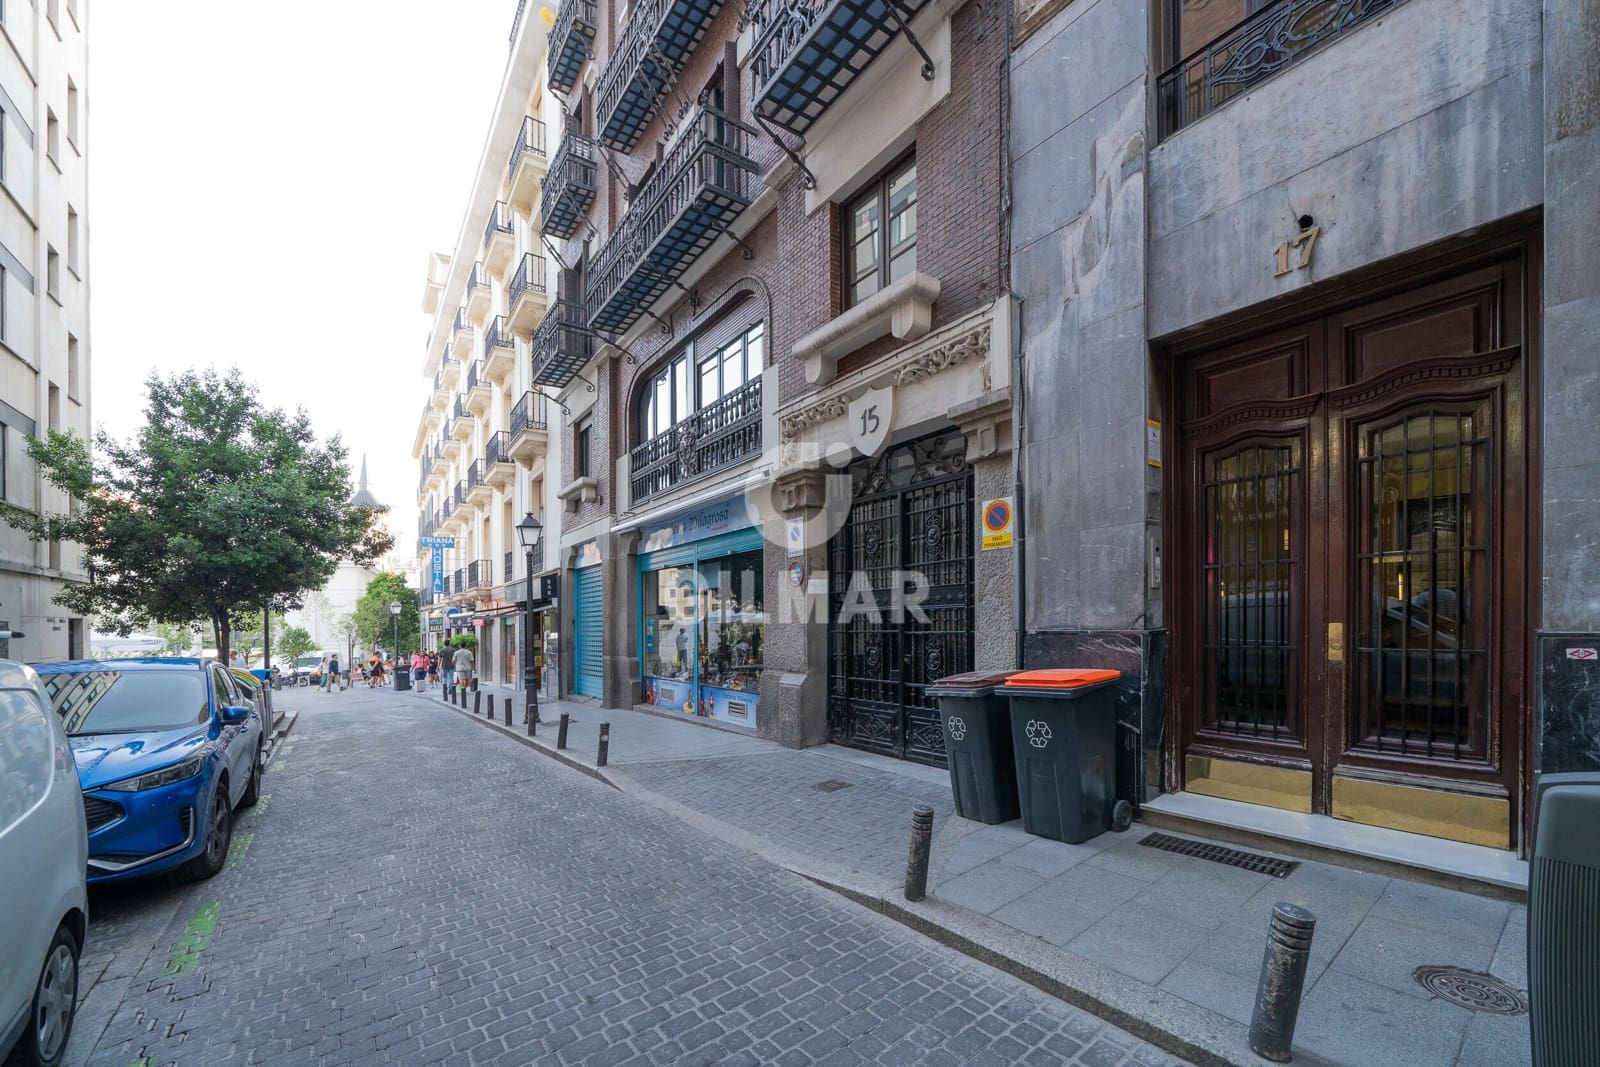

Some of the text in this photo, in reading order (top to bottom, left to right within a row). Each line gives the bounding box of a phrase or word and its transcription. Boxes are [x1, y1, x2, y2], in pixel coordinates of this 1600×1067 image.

[1273, 226, 1320, 278] 17
[860, 404, 880, 437] 15
[420, 536, 454, 545] TRIANA
[433, 548, 442, 593] HOSTAL
